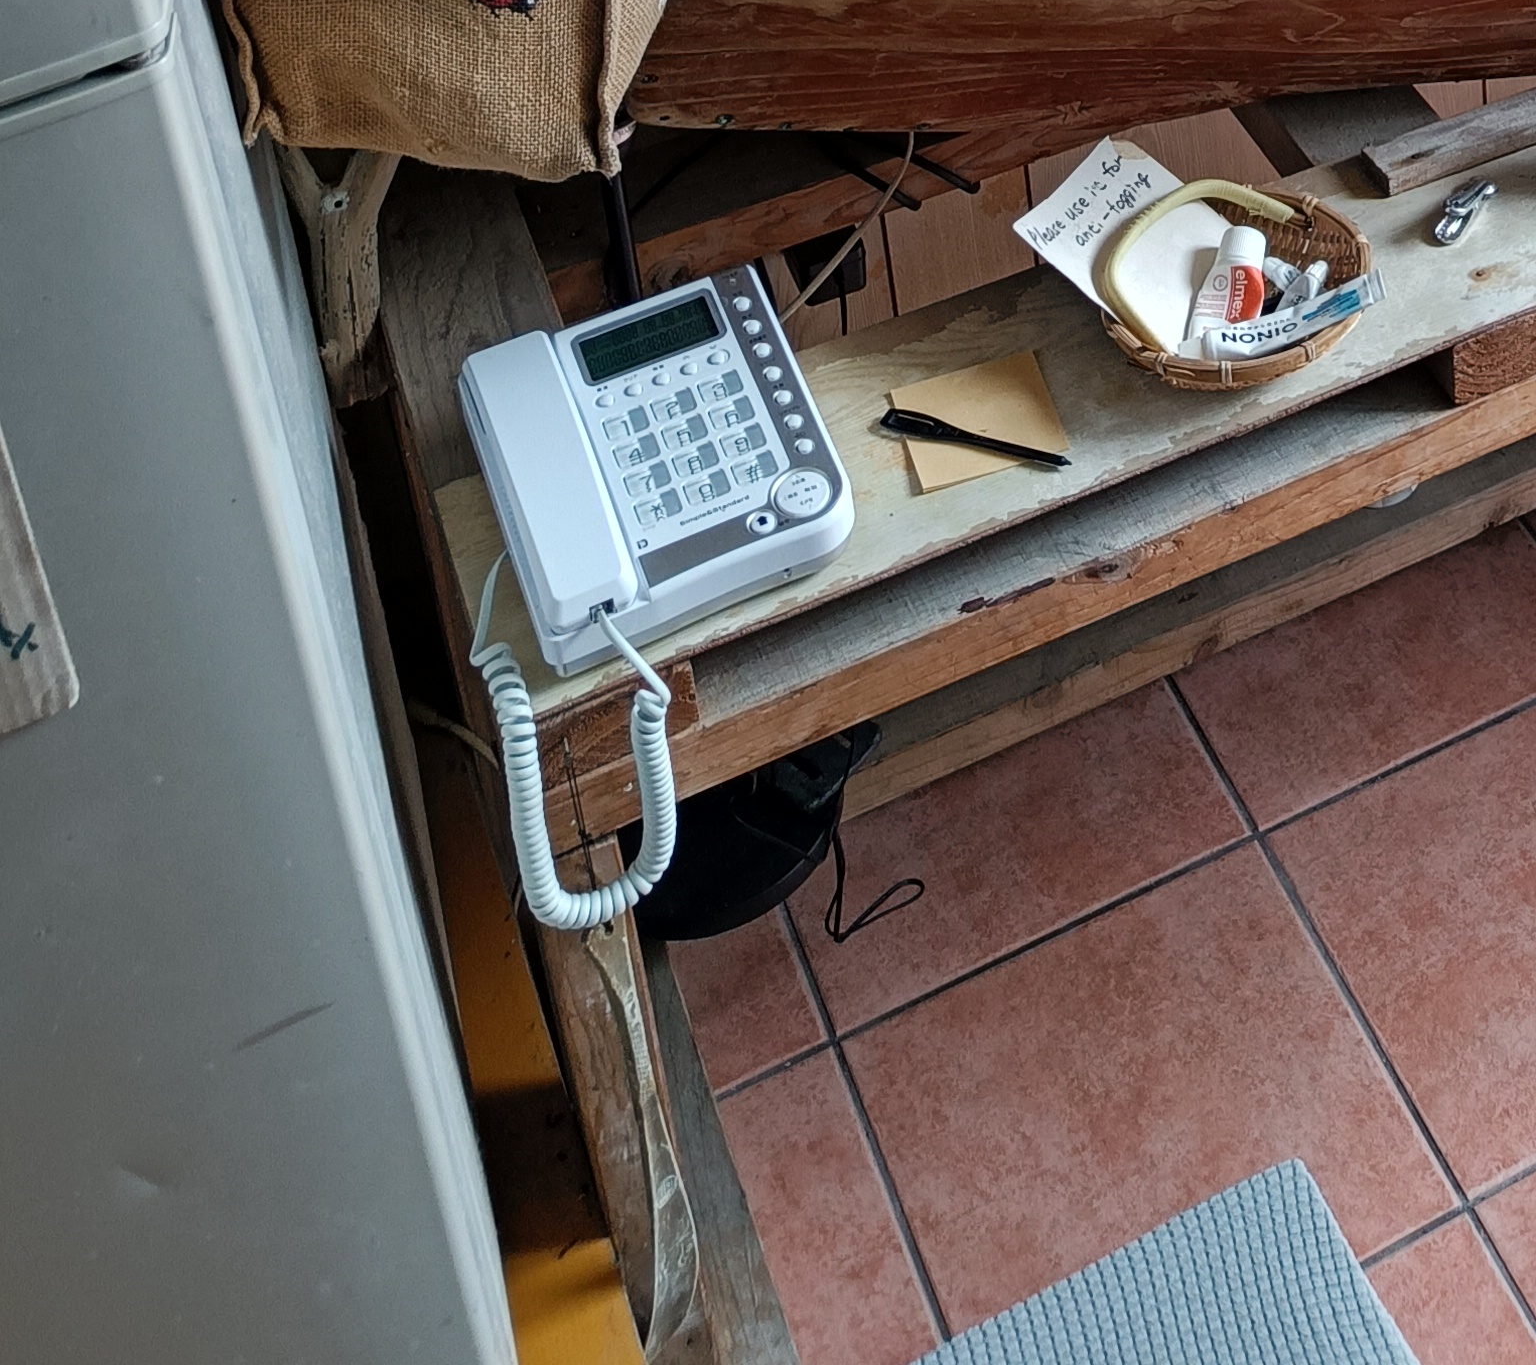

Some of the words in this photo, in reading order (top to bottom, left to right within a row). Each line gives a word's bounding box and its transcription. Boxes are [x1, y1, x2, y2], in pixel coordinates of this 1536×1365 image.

[1026, 220, 1066, 250] Please
[1065, 197, 1090, 221] use
[1101, 155, 1123, 177] for
[1229, 269, 1246, 320] elmex
[1221, 322, 1298, 344] NONIO
